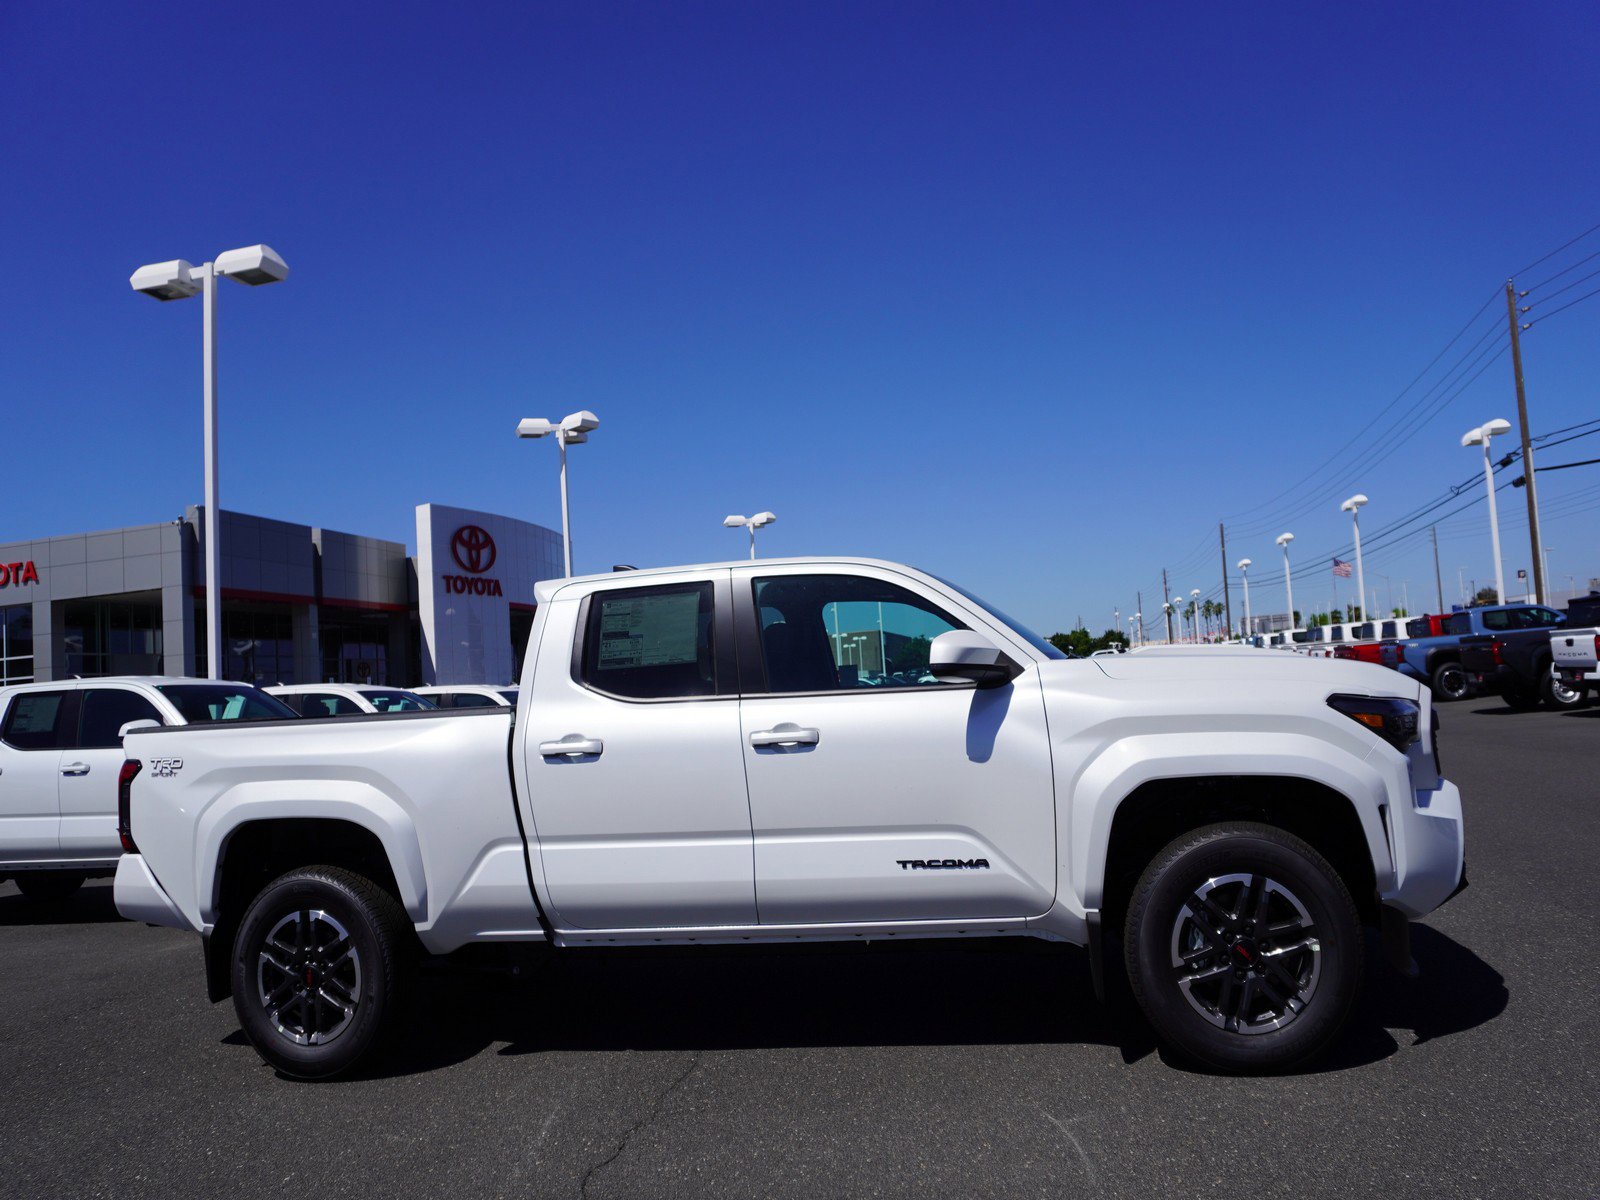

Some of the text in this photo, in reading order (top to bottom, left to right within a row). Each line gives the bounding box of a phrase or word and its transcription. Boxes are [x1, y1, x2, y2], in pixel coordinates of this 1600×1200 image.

[443, 575, 503, 596] TOYOTA
[150, 757, 183, 773] TRD
[896, 859, 990, 870] TACOMA
